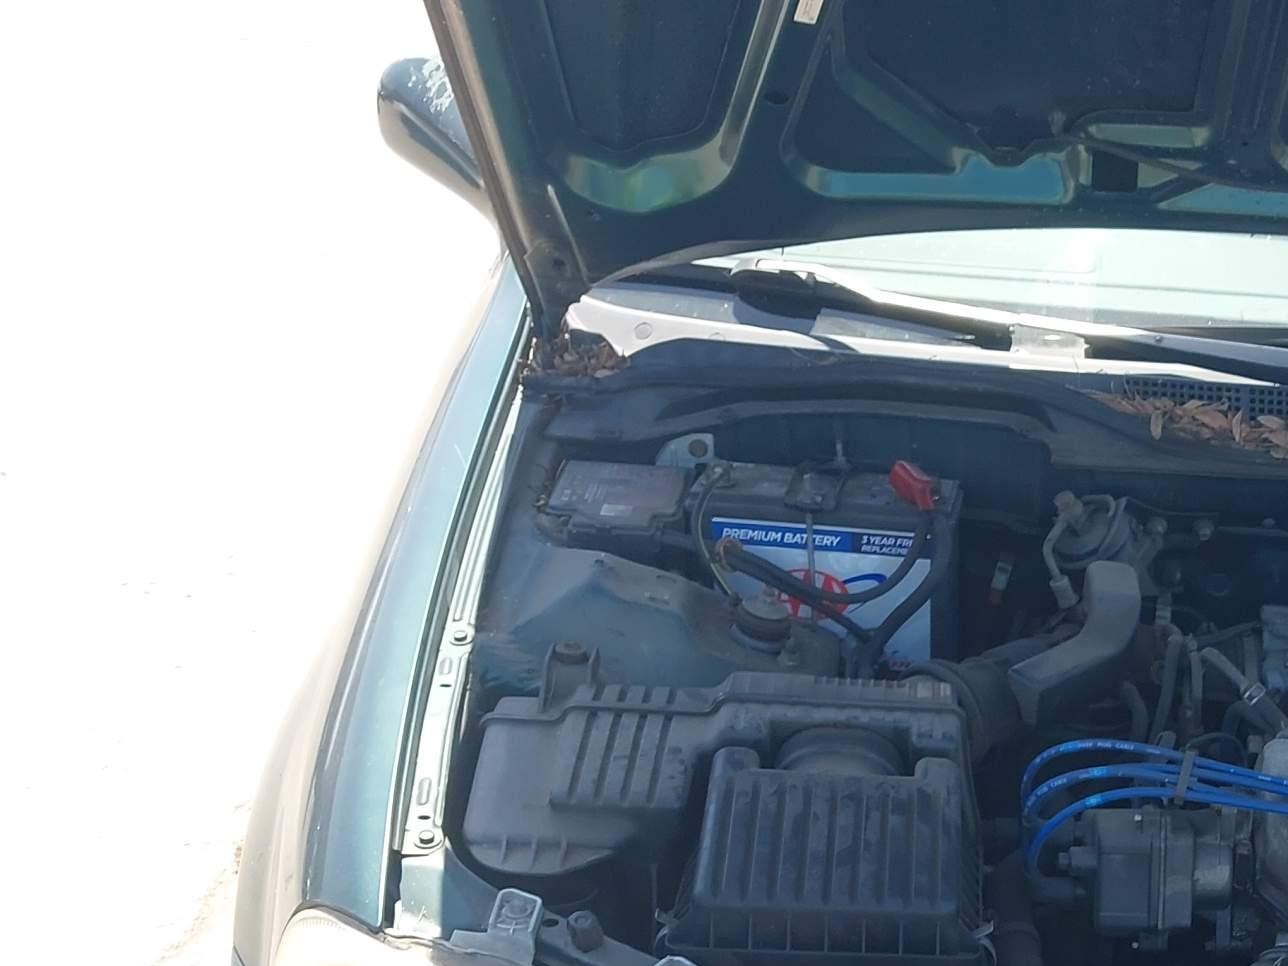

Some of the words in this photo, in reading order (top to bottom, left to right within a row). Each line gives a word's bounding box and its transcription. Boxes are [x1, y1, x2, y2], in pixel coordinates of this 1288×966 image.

[722, 527, 782, 543] PREMIUM
[861, 535, 869, 544] 3
[870, 536, 896, 545] YEAR
